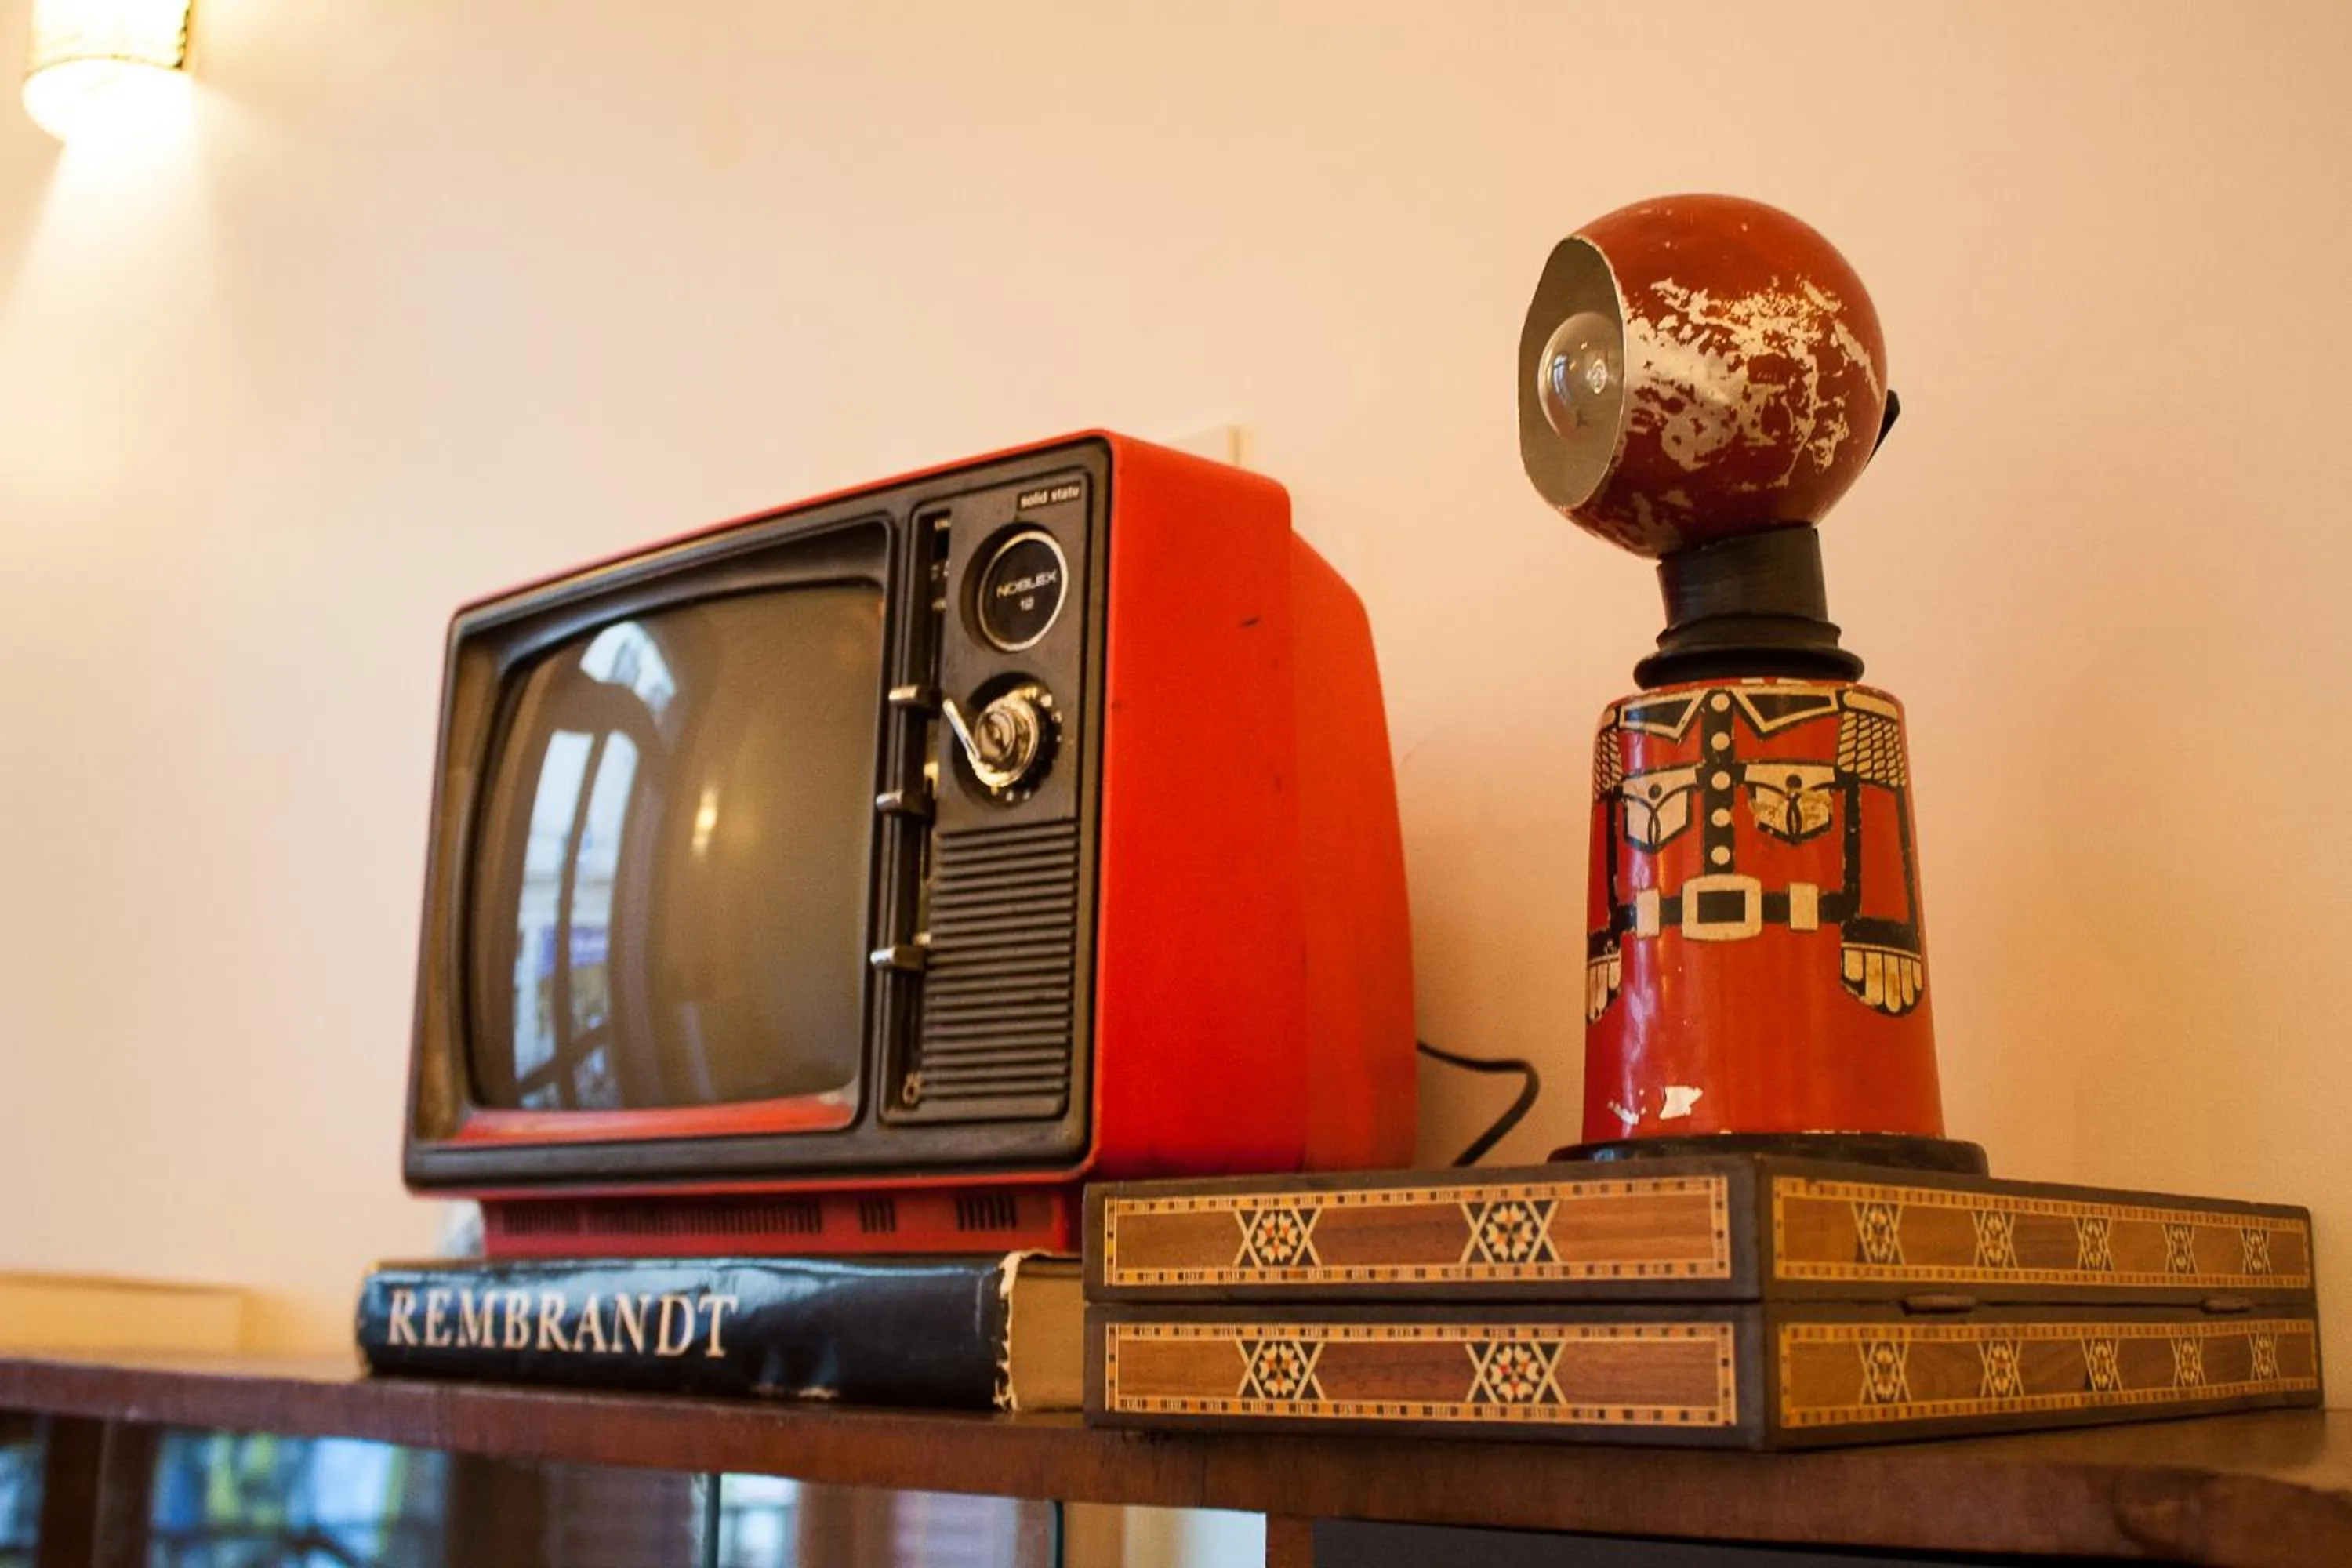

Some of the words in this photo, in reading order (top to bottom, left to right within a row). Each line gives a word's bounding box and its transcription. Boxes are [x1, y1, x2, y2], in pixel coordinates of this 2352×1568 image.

[1021, 490, 1047, 507] solid
[1051, 485, 1080, 501] state
[996, 569, 1057, 598] NOBLEX
[388, 1289, 737, 1358] REMBRANDT
